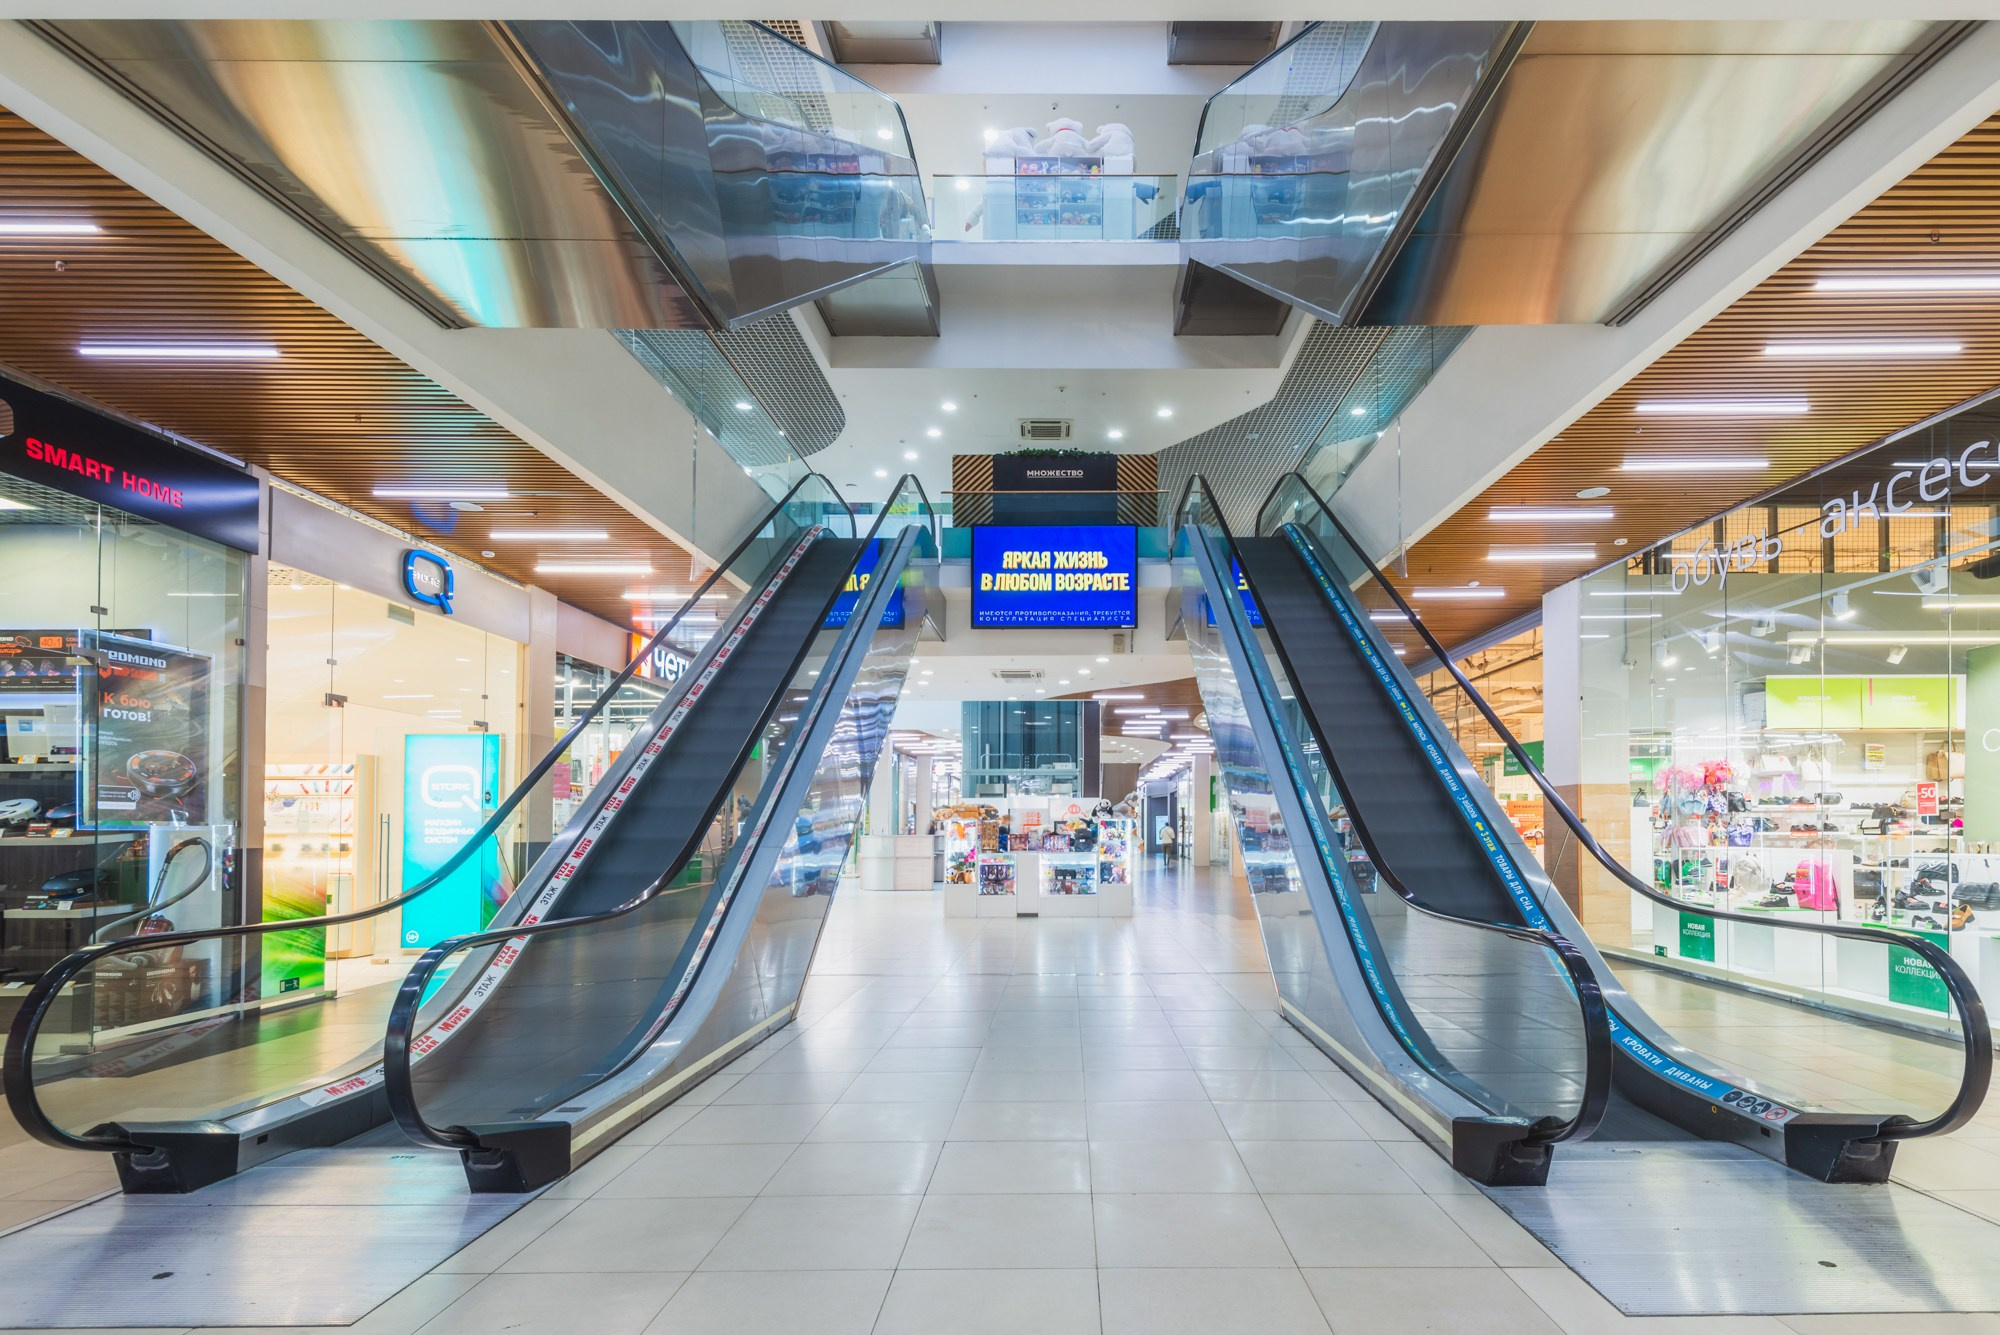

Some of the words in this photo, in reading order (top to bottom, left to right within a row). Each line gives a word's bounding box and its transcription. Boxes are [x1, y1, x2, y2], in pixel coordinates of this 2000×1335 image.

[25, 437, 114, 484] SMART
[122, 471, 183, 508] HOME
[1026, 469, 1083, 477] МНОЖЕСТВО
[1820, 441, 2000, 538] аксес
[1002, 551, 1051, 570] ЯРКАЯ
[1053, 551, 1108, 570] ЖИЗНЬ
[1672, 528, 1783, 593] обувь
[980, 573, 993, 591] В
[993, 573, 1052, 591] ЛЮБОМ
[1055, 573, 1130, 591] ВОЗРАСТЕ
[99, 648, 166, 668] EDMOND
[654, 647, 689, 681] чет
[104, 692, 115, 704] К
[120, 694, 151, 709] бою
[1412, 722, 1429, 742] МАТРАСЫ
[1426, 744, 1443, 766] КРОВАТИ
[1439, 768, 1459, 792] ДИВАНЫ
[603, 796, 618, 811] PIZZA
[1461, 800, 1478, 819] askona
[593, 815, 609, 832] ЭТАЖ
[553, 862, 571, 880] PIZZA
[1483, 837, 1497, 853] этаж
[1494, 854, 1515, 880] ТОВАРЫ
[1508, 880, 1524, 896] ДЛЯ
[1519, 895, 1534, 912] СНА
[540, 886, 559, 906] ЭТАЖ
[1348, 915, 1367, 952] ДИВАНЫ
[1682, 929, 1711, 939] КОЛЛЕКЦИЯ
[1687, 922, 1706, 931] НОВАЯ
[492, 945, 513, 967] PIZZA
[1364, 958, 1384, 995] КРОВАТИ
[1895, 965, 1941, 979] КОЛЛЕКЦИ
[474, 974, 497, 997] ЭТАЖ
[1622, 1036, 1663, 1066] КРОВАТИ
[1664, 1066, 1713, 1090] ДИВАНЫ
